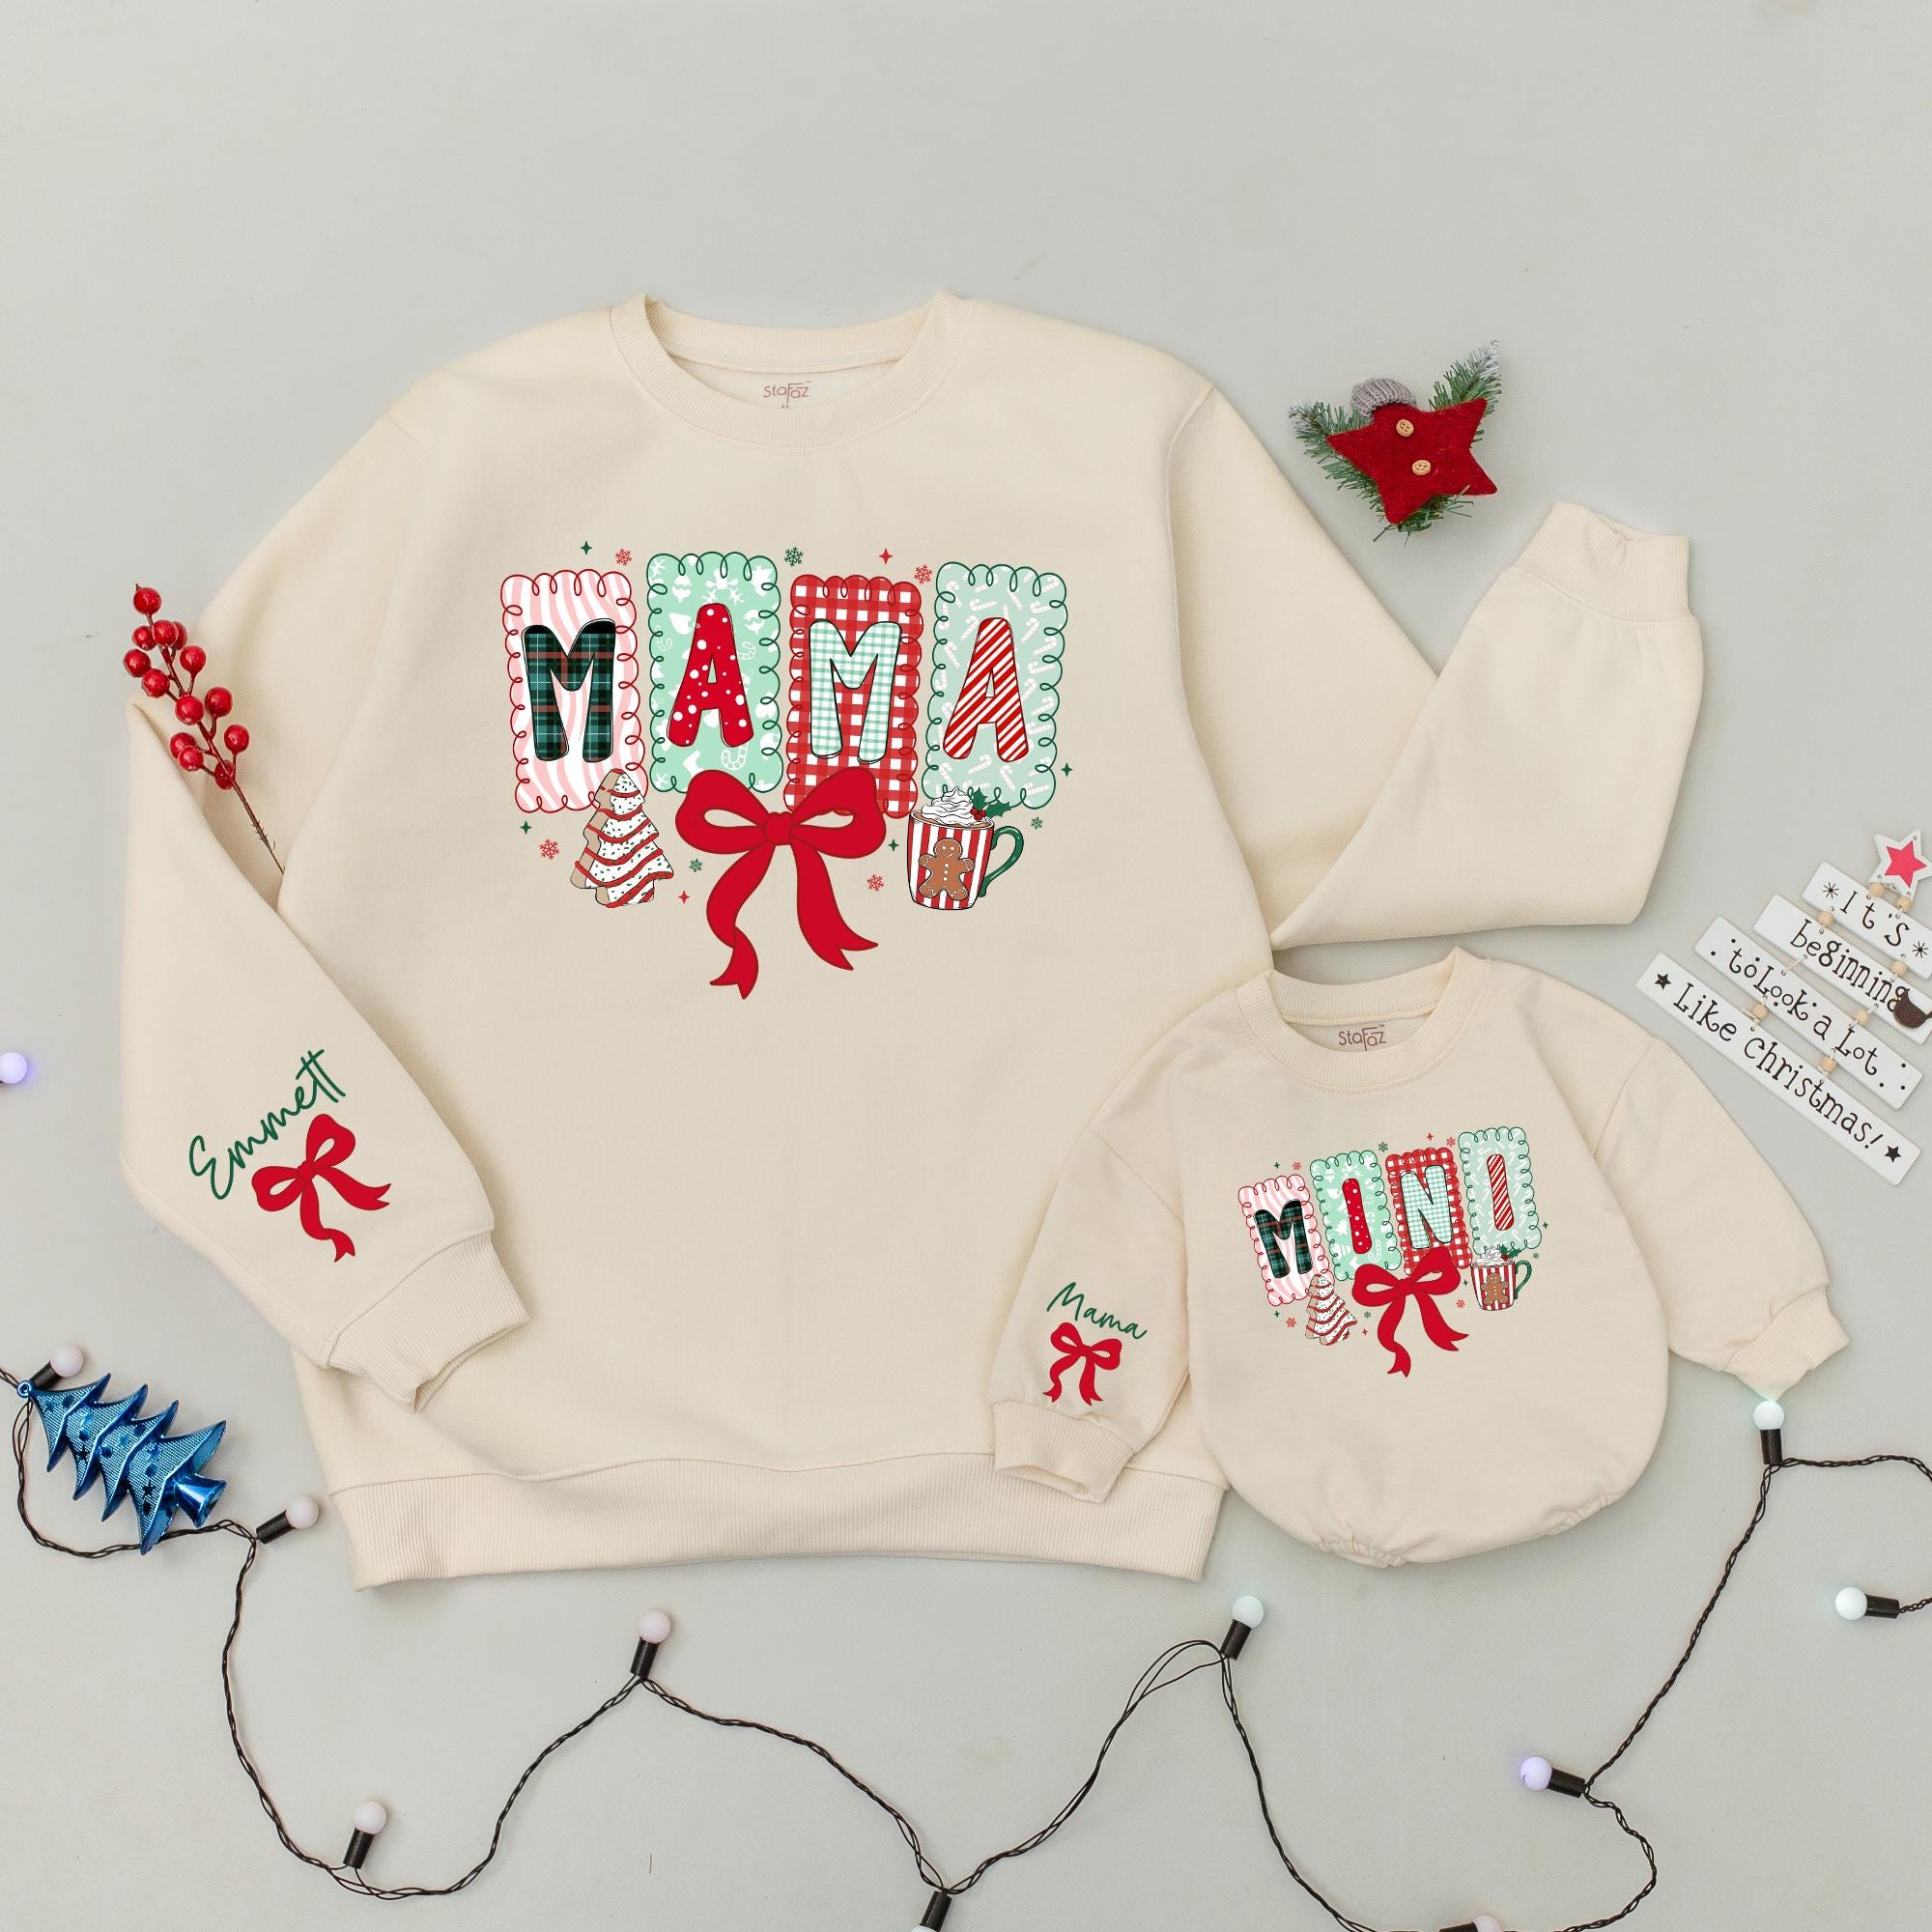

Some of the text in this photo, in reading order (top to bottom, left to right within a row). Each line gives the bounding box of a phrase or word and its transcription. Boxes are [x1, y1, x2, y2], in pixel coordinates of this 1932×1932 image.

[521, 603, 1030, 765] MAMA
[1673, 982, 1884, 1150] Like Christmas!
[1813, 1014, 1833, 1041] a
[188, 1048, 347, 1200] Emmett
[1254, 1153, 1515, 1278] MINI
[1046, 1281, 1149, 1340] Mama
